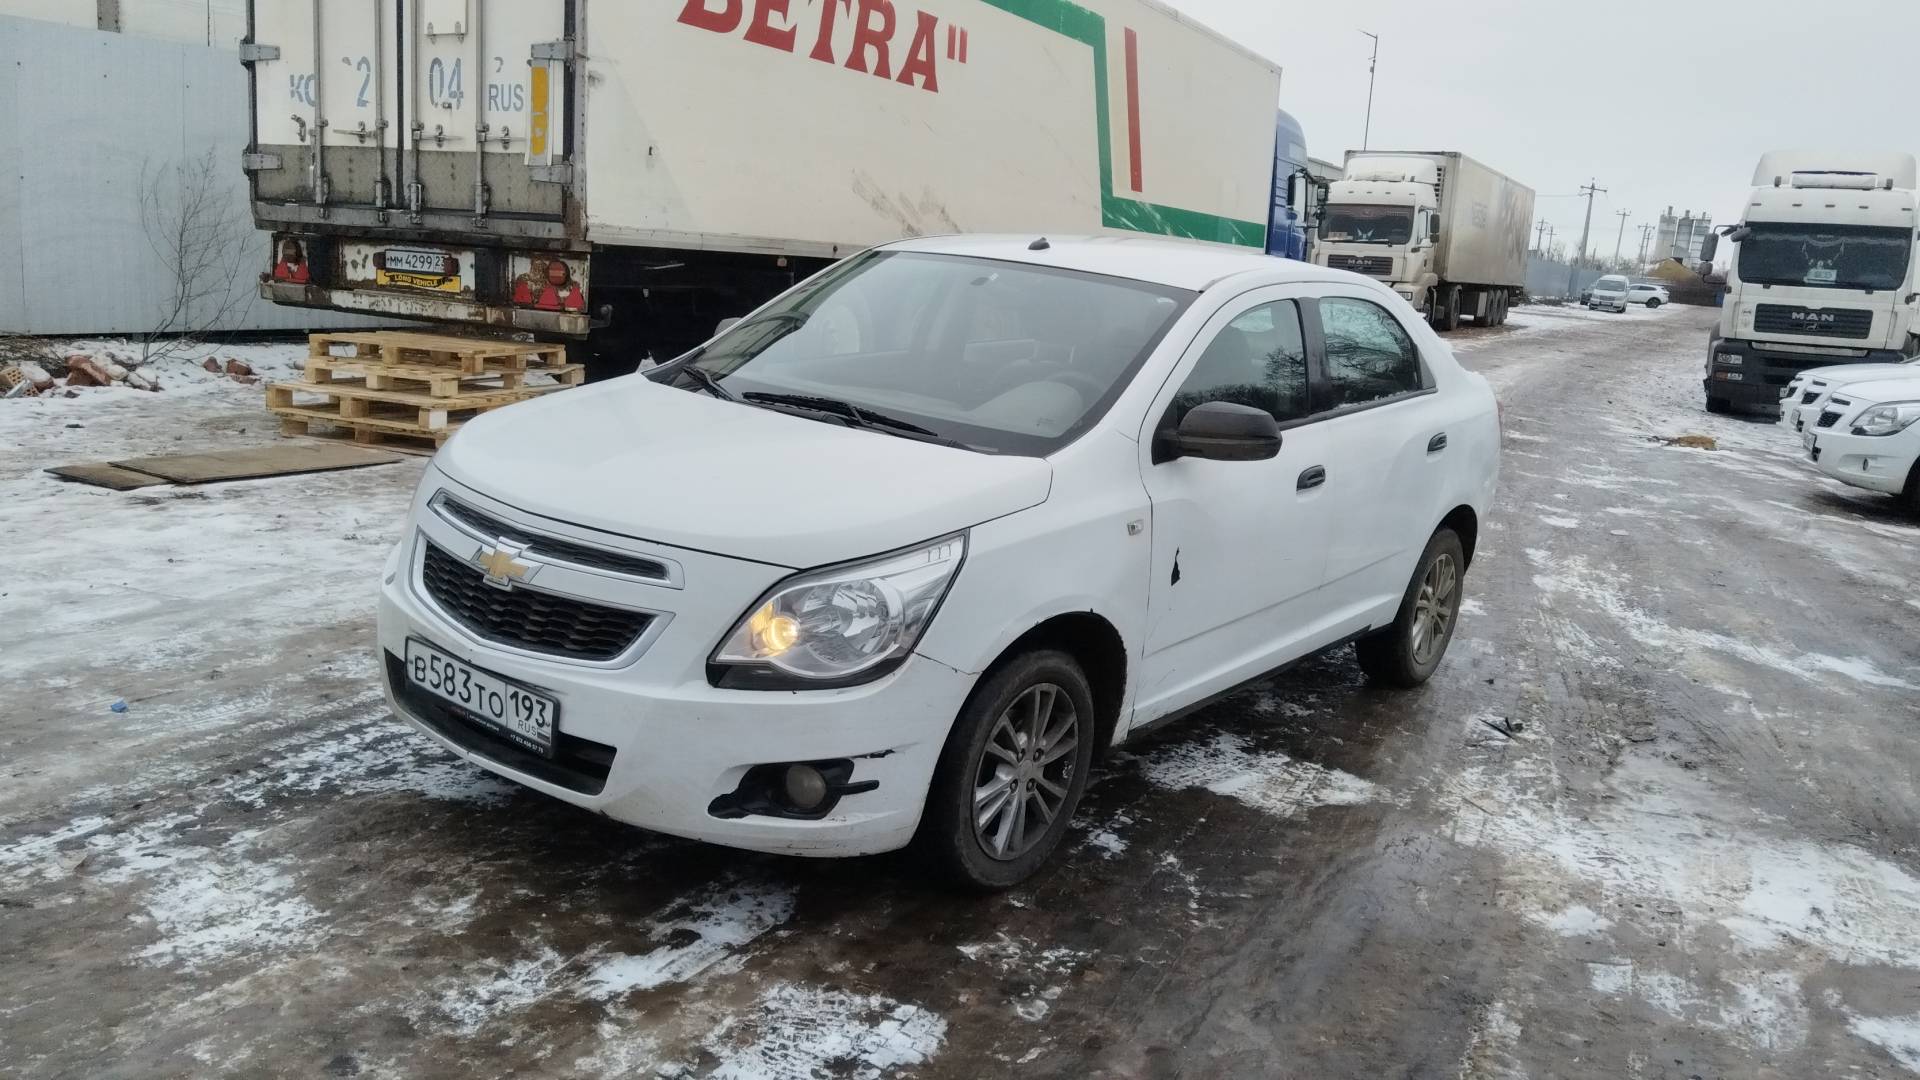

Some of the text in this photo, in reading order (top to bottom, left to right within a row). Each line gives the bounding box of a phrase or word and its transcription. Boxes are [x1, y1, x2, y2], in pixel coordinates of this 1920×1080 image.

[488, 83, 524, 112] RUS
[1792, 311, 1834, 321] MAN
[509, 690, 547, 728] 193
[518, 719, 537, 736] RUS
